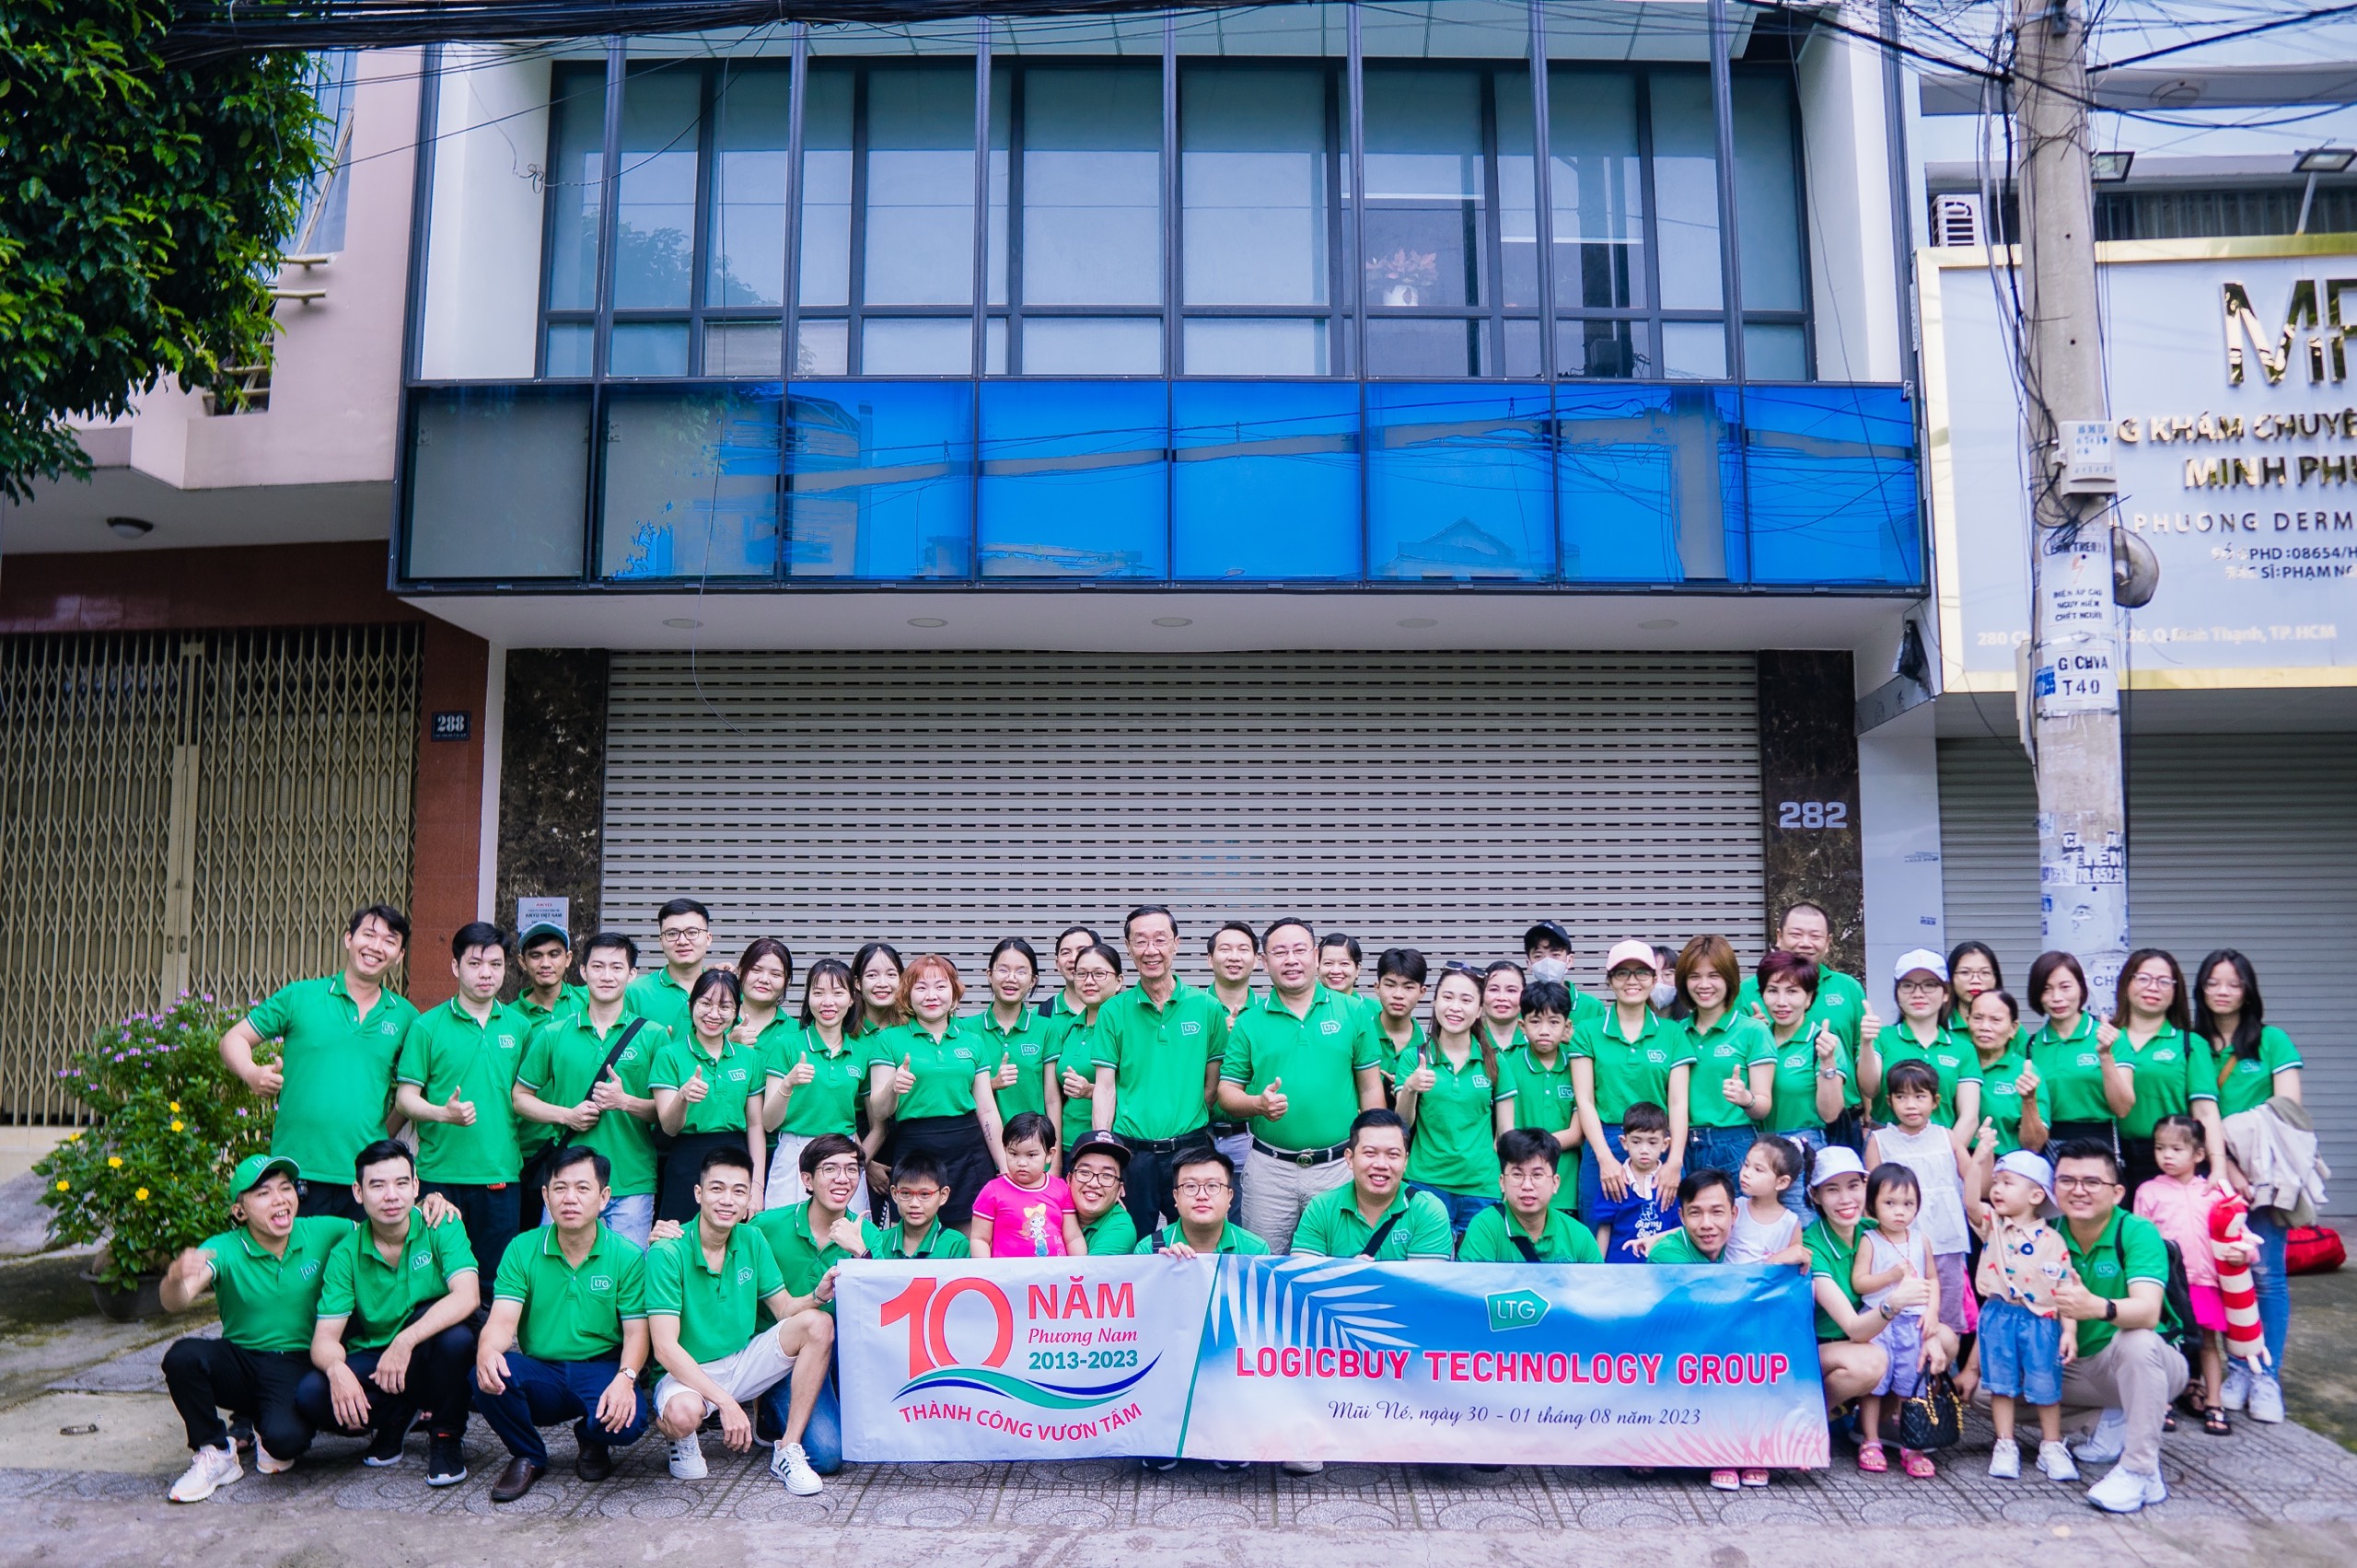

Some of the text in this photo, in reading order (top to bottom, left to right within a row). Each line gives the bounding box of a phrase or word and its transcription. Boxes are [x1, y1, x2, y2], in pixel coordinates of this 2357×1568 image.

[2150, 411, 2245, 442] KHÁM
[2184, 457, 2287, 488] MINH
[2133, 512, 2258, 534] PHUONG
[437, 714, 465, 733] 288
[1779, 801, 1848, 829] 282
[1184, 1024, 1197, 1032] LTG
[1323, 1023, 1337, 1031] LTG
[1394, 1232, 1408, 1241] LTG
[595, 1280, 609, 1288] LTG
[1028, 1275, 1135, 1320] NĂM
[1496, 1299, 1536, 1319] LTG
[879, 1276, 1014, 1379] 10
[1028, 1328, 1138, 1347] Phương Nam
[1028, 1349, 1139, 1371] 2013-2023
[1235, 1345, 1788, 1385] LOGICBUY TECHNOLOGY GROUP
[899, 1400, 1143, 1442] THÀNH CÔNG VƯƠN TẦM
[1328, 1400, 1372, 1420] Mũi
[1376, 1400, 1413, 1421] Né,
[1419, 1406, 1462, 1426] ngày
[1466, 1406, 1489, 1422] 30
[1510, 1407, 1530, 1423] 01
[1537, 1405, 1586, 1429] tháng
[1589, 1407, 1611, 1423] 08
[1617, 1410, 1655, 1424] năm
[1658, 1408, 1701, 1424] 2023
